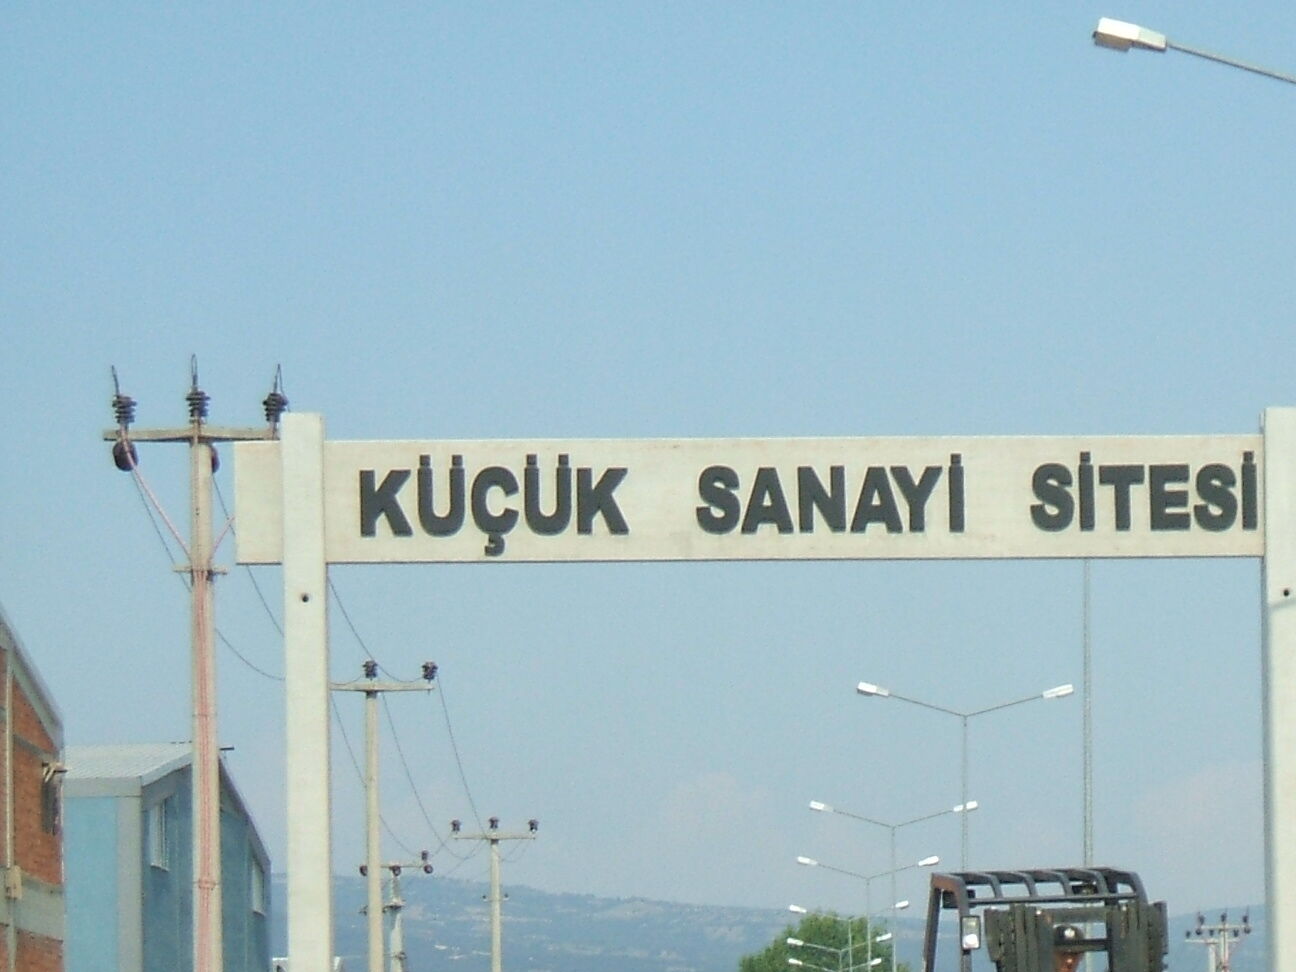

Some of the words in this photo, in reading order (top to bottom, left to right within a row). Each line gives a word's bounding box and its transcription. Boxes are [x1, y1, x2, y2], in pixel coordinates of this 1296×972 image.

[359, 453, 629, 557] KÜÇÜK
[695, 453, 965, 535] SANAYİ
[1030, 451, 1258, 532] SİTESİ
